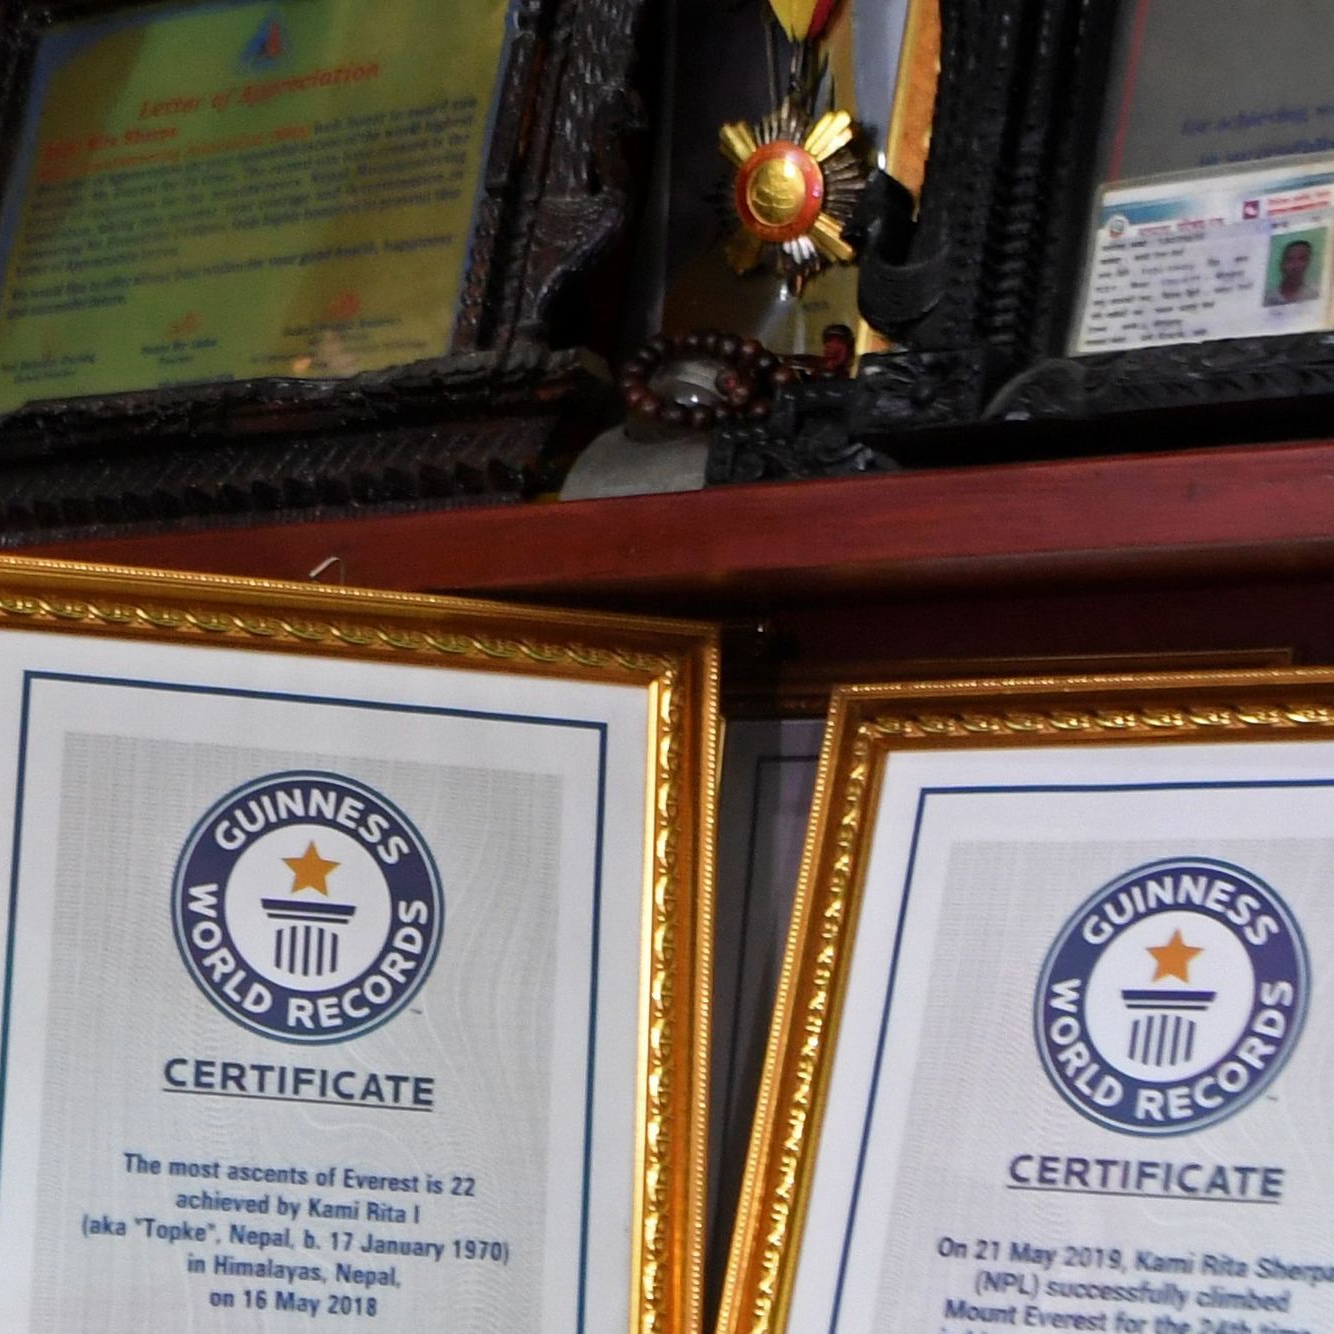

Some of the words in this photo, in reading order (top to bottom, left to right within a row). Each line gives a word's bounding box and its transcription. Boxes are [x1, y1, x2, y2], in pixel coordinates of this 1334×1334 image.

[215, 789, 409, 864] GUINNESS
[1083, 874, 1279, 945] GUINNESS
[189, 883, 272, 1016] WORLD
[288, 900, 428, 1029] RECORDS
[1052, 978, 1123, 1108] WORLD
[1135, 980, 1293, 1121] RECORDS
[165, 1058, 434, 1106] CERTIFICATE
[124, 1153, 162, 1175] The
[169, 1159, 220, 1179] most
[227, 1164, 307, 1185] ascents
[316, 1167, 335, 1187] of
[344, 1169, 419, 1193] Everest
[426, 1175, 443, 1194] is
[451, 1176, 475, 1197] 22
[1009, 1155, 1285, 1197] CERTIFICATE
[176, 1191, 268, 1215] achieved
[276, 1194, 300, 1219] by
[309, 1198, 358, 1220] Kami
[367, 1202, 407, 1222] Rita
[82, 1215, 126, 1238] (aka
[303, 1229, 321, 1250] b.
[330, 1231, 353, 1251] 17
[361, 1233, 444, 1262] January
[453, 1239, 509, 1265] 1970)
[938, 1237, 966, 1259] On
[974, 1239, 999, 1261] 21
[1009, 1242, 1056, 1269] May
[1066, 1246, 1126, 1273] 2019,
[1135, 1251, 1193, 1274] Kami
[1201, 1254, 1247, 1277] Rita
[187, 1253, 205, 1274] in
[214, 1256, 327, 1284] Himalayas,
[335, 1264, 401, 1288] Nepal,
[975, 1271, 1039, 1298] (NPL)
[1046, 1279, 1189, 1310] successfully
[1196, 1287, 1290, 1312] climbed
[209, 1289, 235, 1308] on
[244, 1289, 267, 1310] 16
[276, 1291, 320, 1318] May
[328, 1294, 377, 1318] 2018
[944, 1299, 1016, 1324] Mount
[1024, 1305, 1106, 1332] Everest
[1114, 1311, 1146, 1334] for
